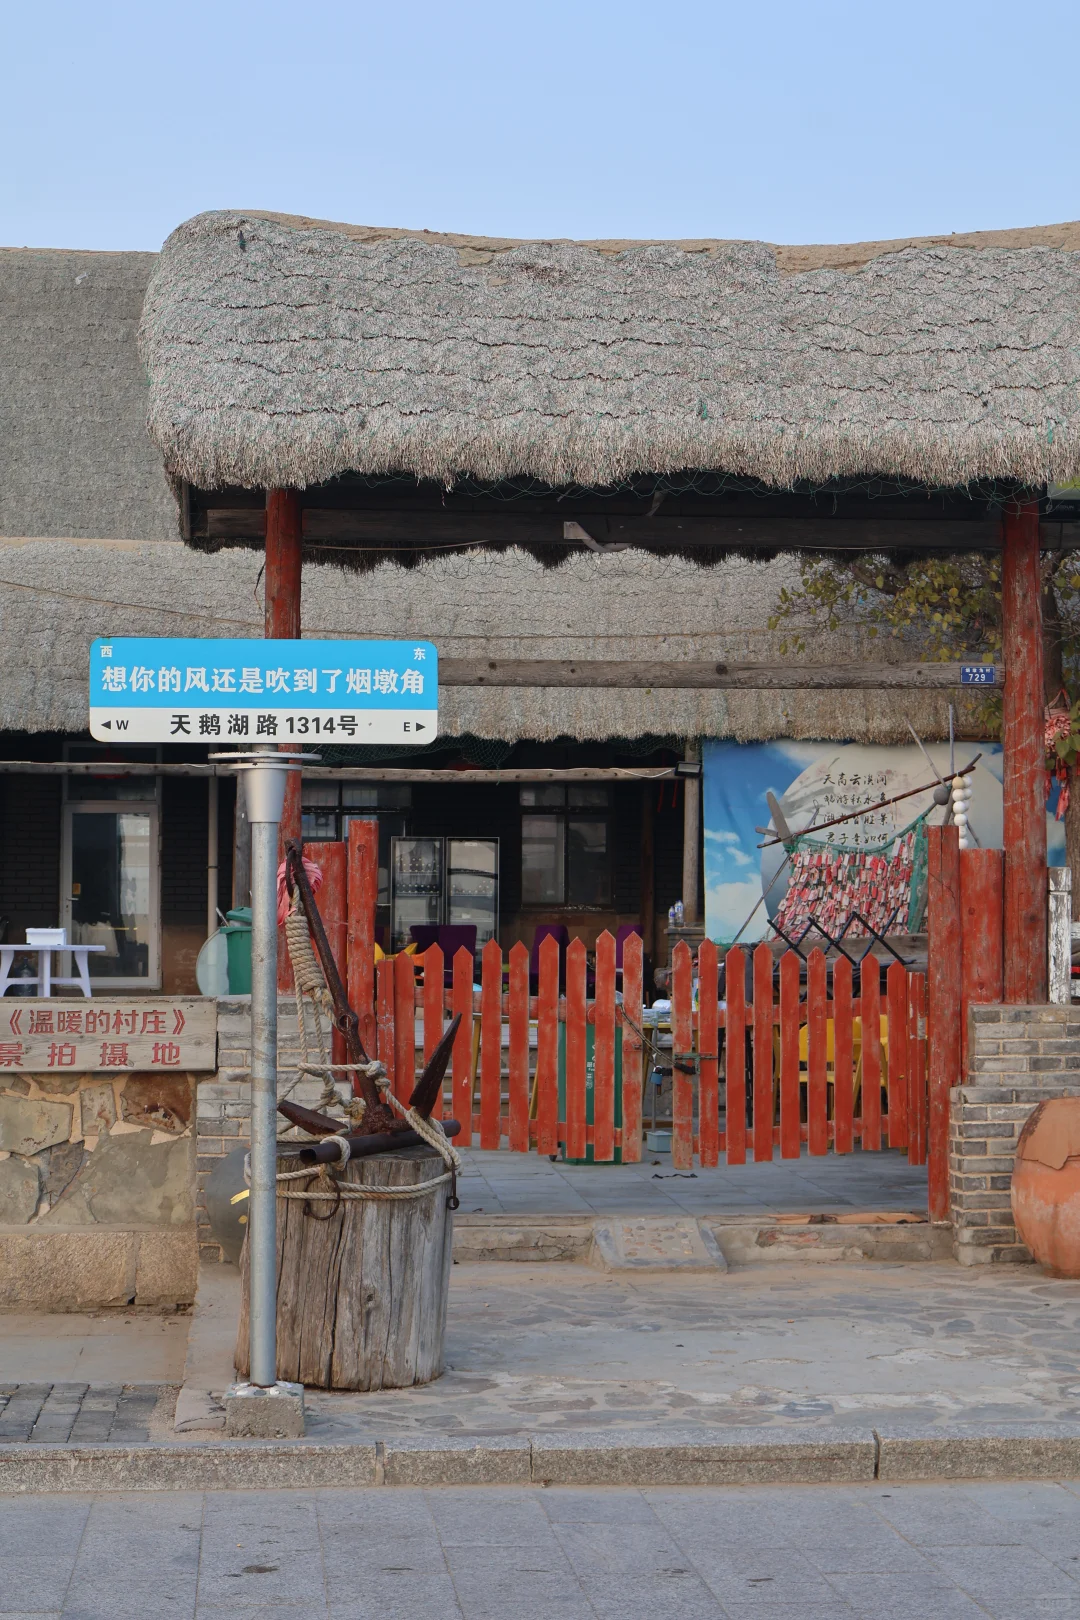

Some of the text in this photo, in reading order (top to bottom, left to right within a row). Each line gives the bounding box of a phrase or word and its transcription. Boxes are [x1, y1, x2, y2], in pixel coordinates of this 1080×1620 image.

[100, 645, 113, 658] 西
[413, 647, 426, 661] 东
[101, 666, 425, 695] 想你的风还是吹到了烟墩角
[968, 673, 986, 682] 729
[116, 719, 129, 731] W
[170, 713, 359, 736] 天鹅湖路1314号
[403, 721, 411, 732] E
[9, 1009, 186, 1036] 《温暖的村庄》
